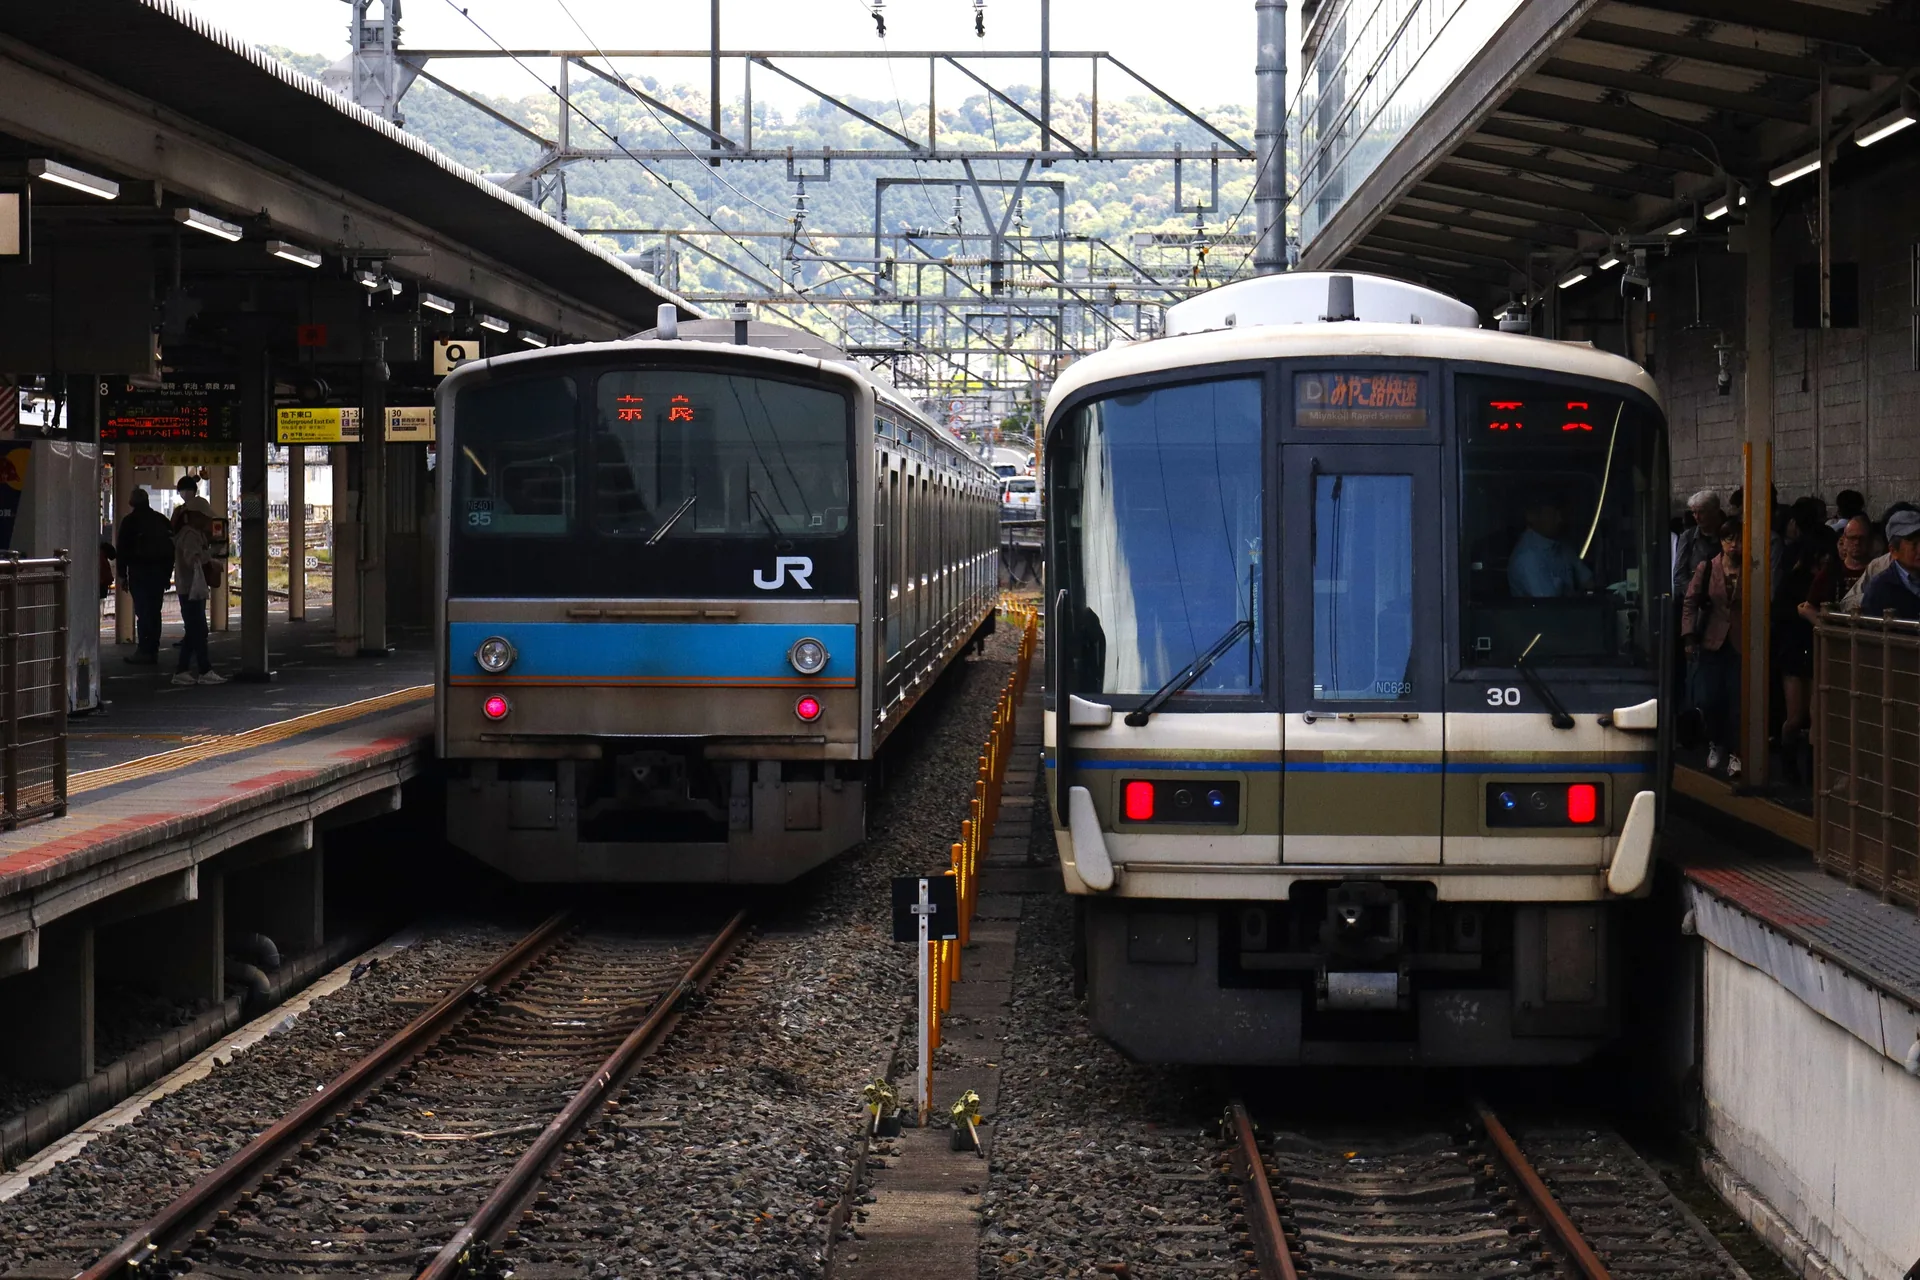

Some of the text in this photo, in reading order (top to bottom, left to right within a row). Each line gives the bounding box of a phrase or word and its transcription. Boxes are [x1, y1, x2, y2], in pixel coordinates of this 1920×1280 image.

[445, 344, 466, 372] 9
[100, 382, 109, 396] 8
[1306, 381, 1323, 400] D
[1330, 376, 1417, 407] みやこ路快速
[391, 409, 402, 417] 30
[1309, 411, 1411, 422] Miyakoji Rapid Service
[468, 511, 492, 526] 35
[270, 547, 280, 556] 35
[305, 557, 317, 567] 35
[753, 556, 813, 590] JR
[1376, 682, 1411, 694] NC628
[1486, 687, 1521, 706] 30
